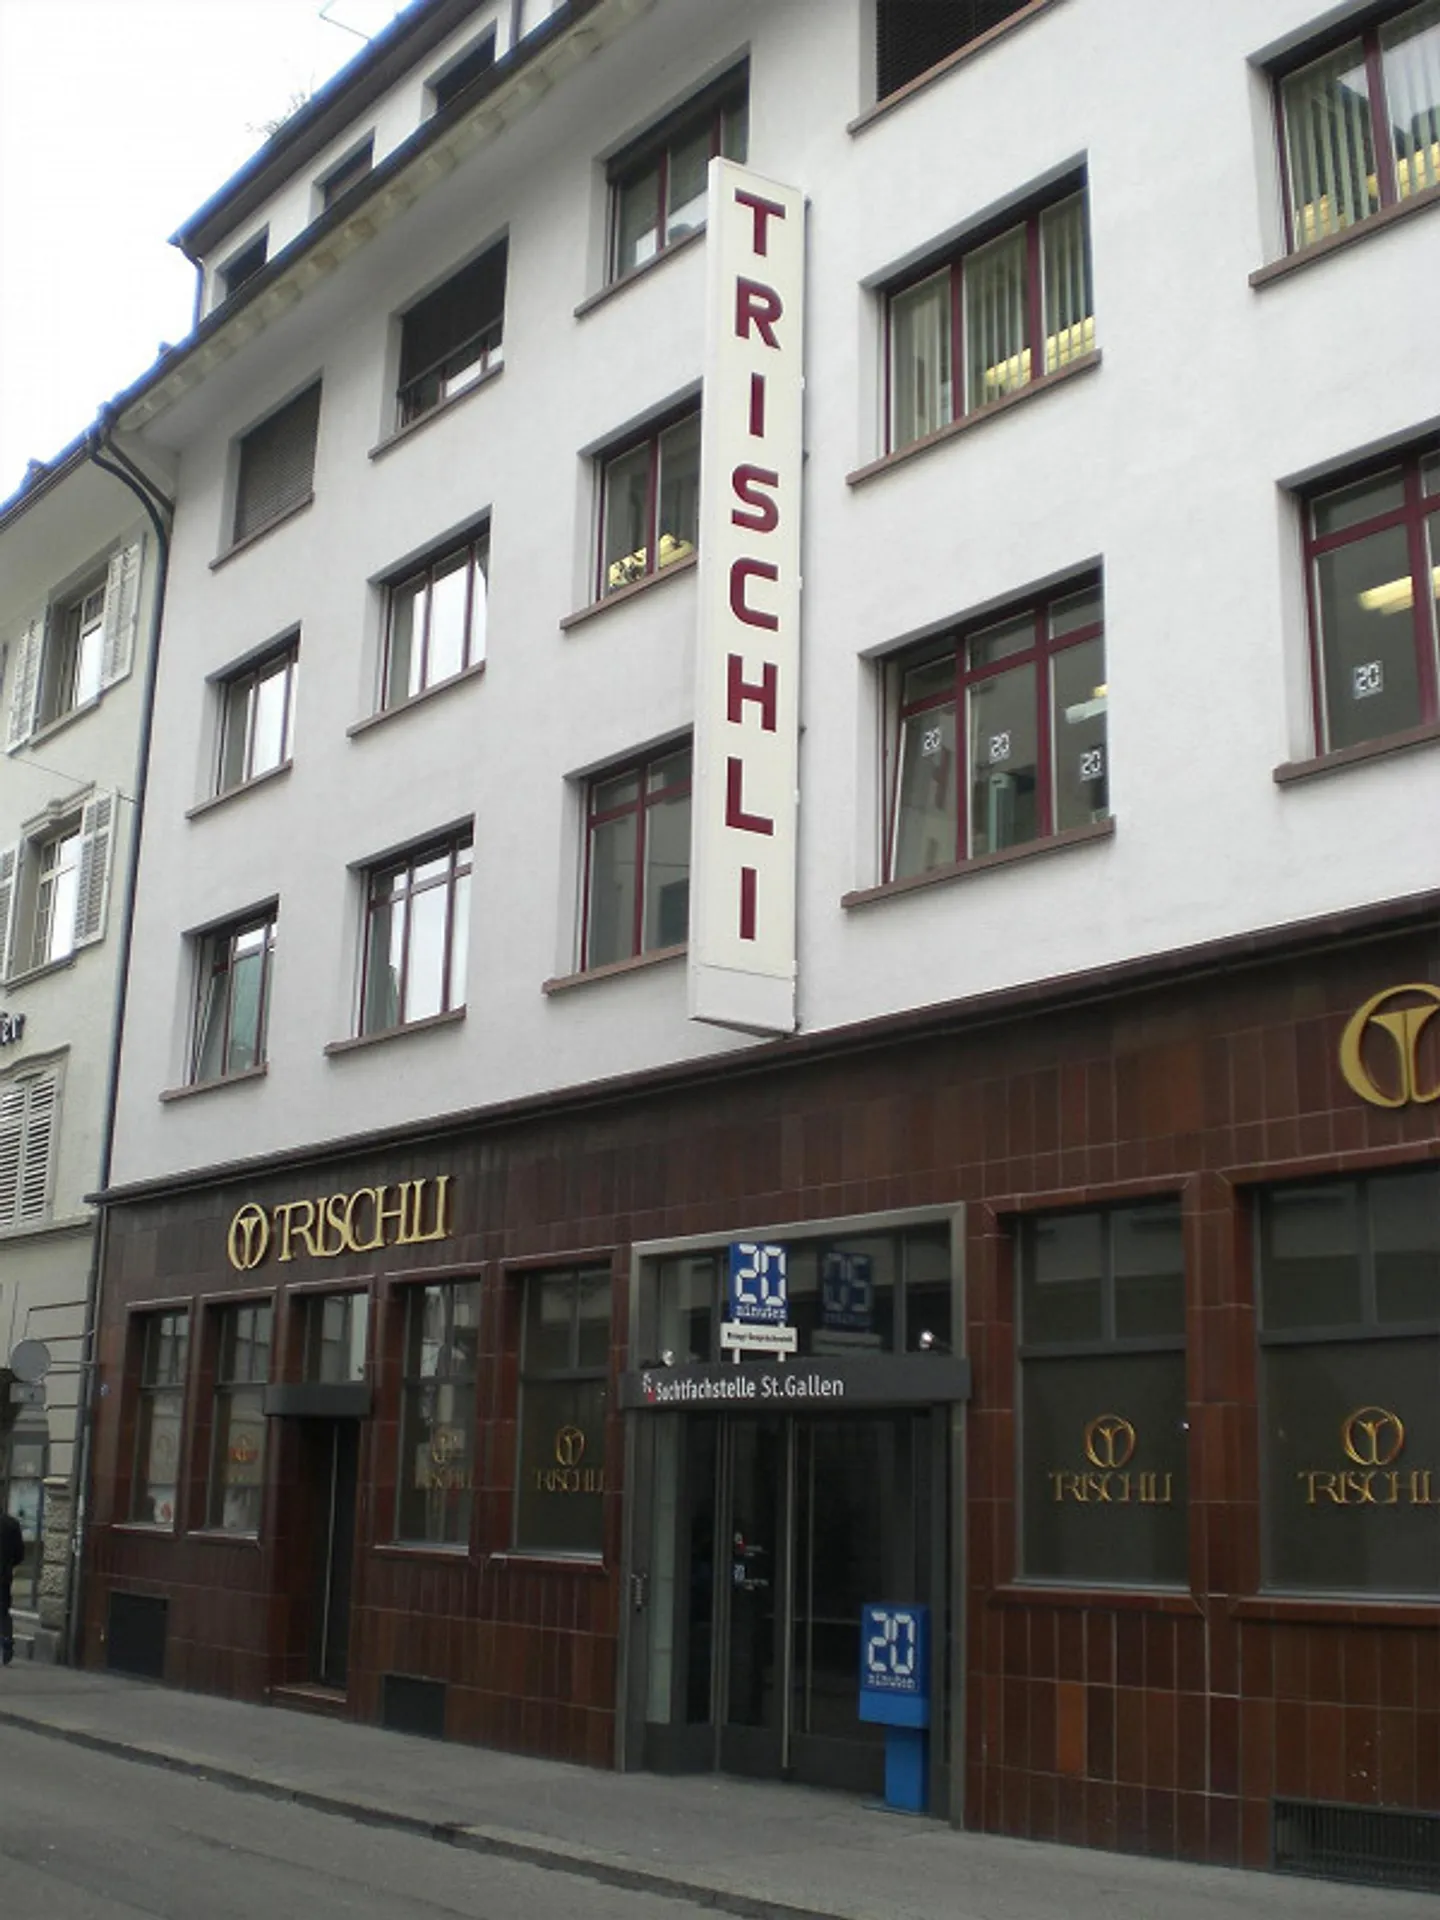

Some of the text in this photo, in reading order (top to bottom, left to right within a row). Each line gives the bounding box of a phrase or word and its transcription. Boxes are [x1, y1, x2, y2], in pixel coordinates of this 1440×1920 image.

[725, 189, 785, 941] TRISCHLI
[1355, 663, 1380, 690] 20
[273, 1175, 450, 1262] TRISCHLI
[735, 1243, 787, 1307] 20
[1048, 1472, 1172, 1503] TRISCHLI
[868, 1611, 915, 1674] 20
